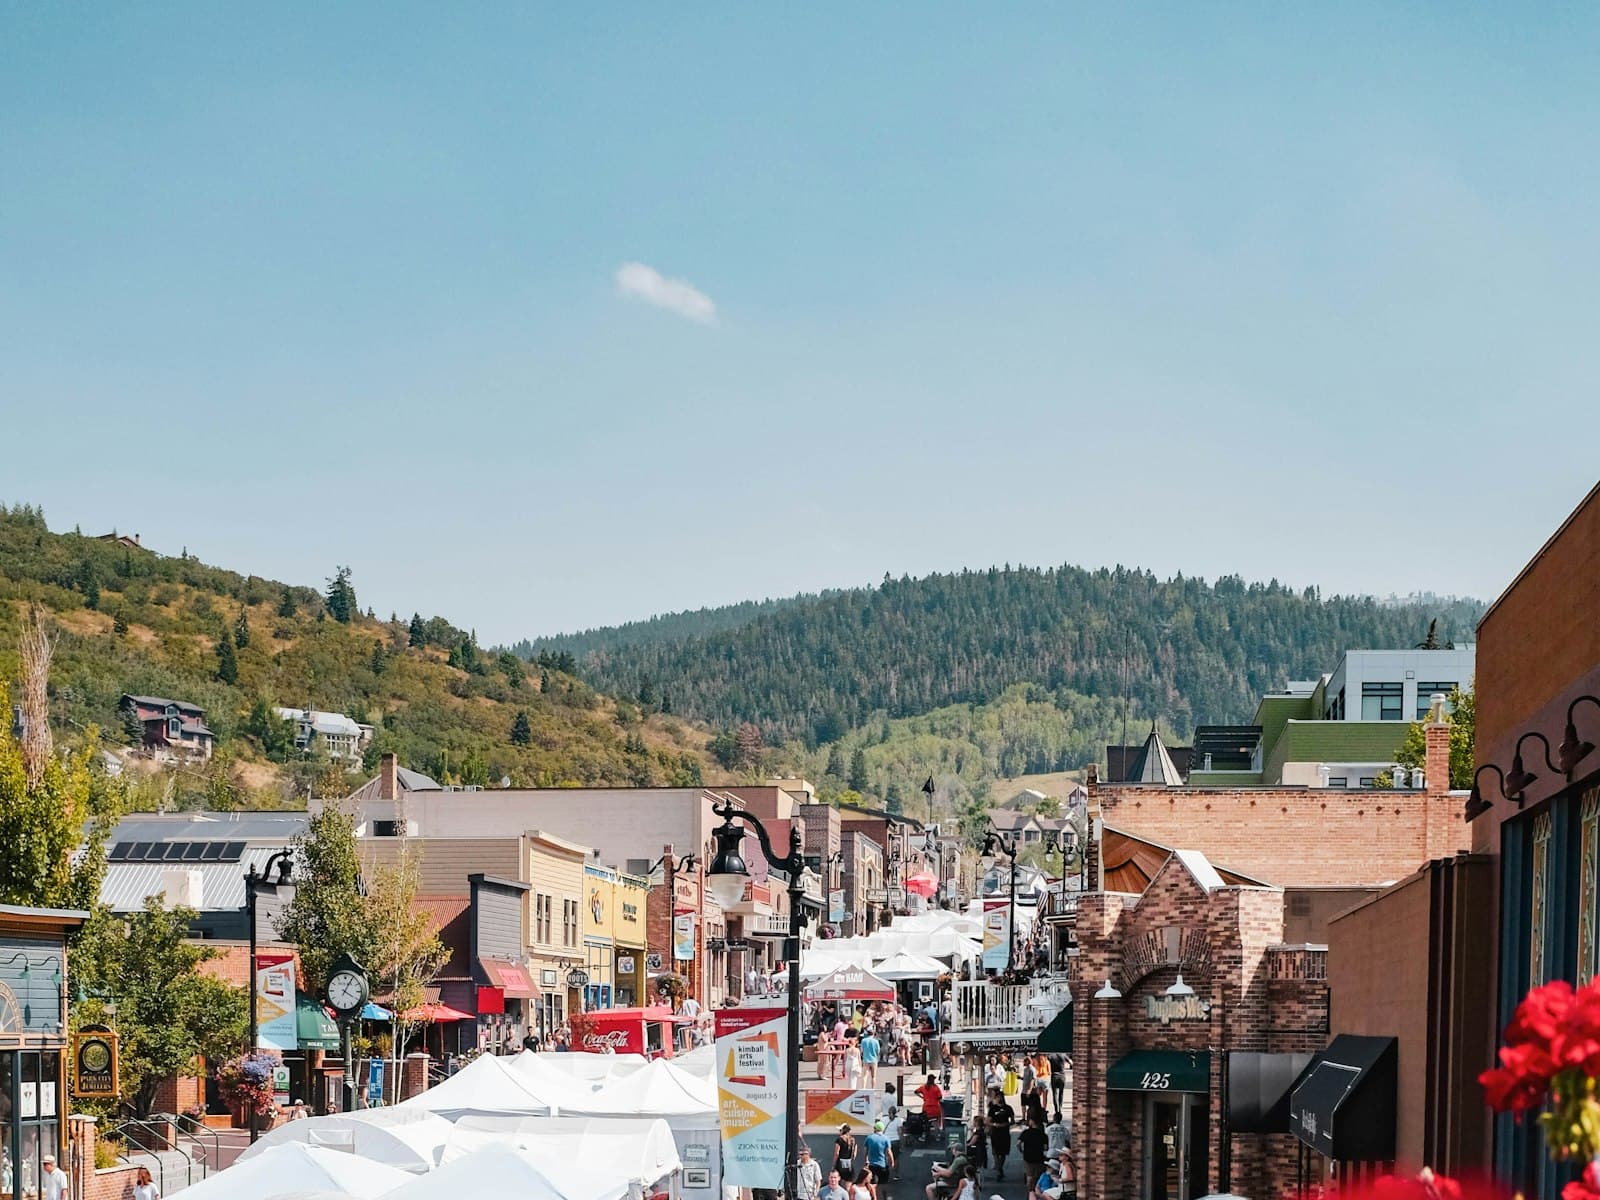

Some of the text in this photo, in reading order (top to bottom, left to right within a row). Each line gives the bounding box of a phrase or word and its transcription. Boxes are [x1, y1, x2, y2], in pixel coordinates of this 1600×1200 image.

[567, 974, 588, 982] ROOTS
[972, 1039, 1011, 1047] WOODBURY
[738, 1045, 764, 1053] kimball
[1140, 1072, 1171, 1089] 425
[746, 1092, 767, 1100] august
[723, 1100, 738, 1108] art.
[723, 1108, 757, 1118] cuisine.
[723, 1118, 753, 1127] music.
